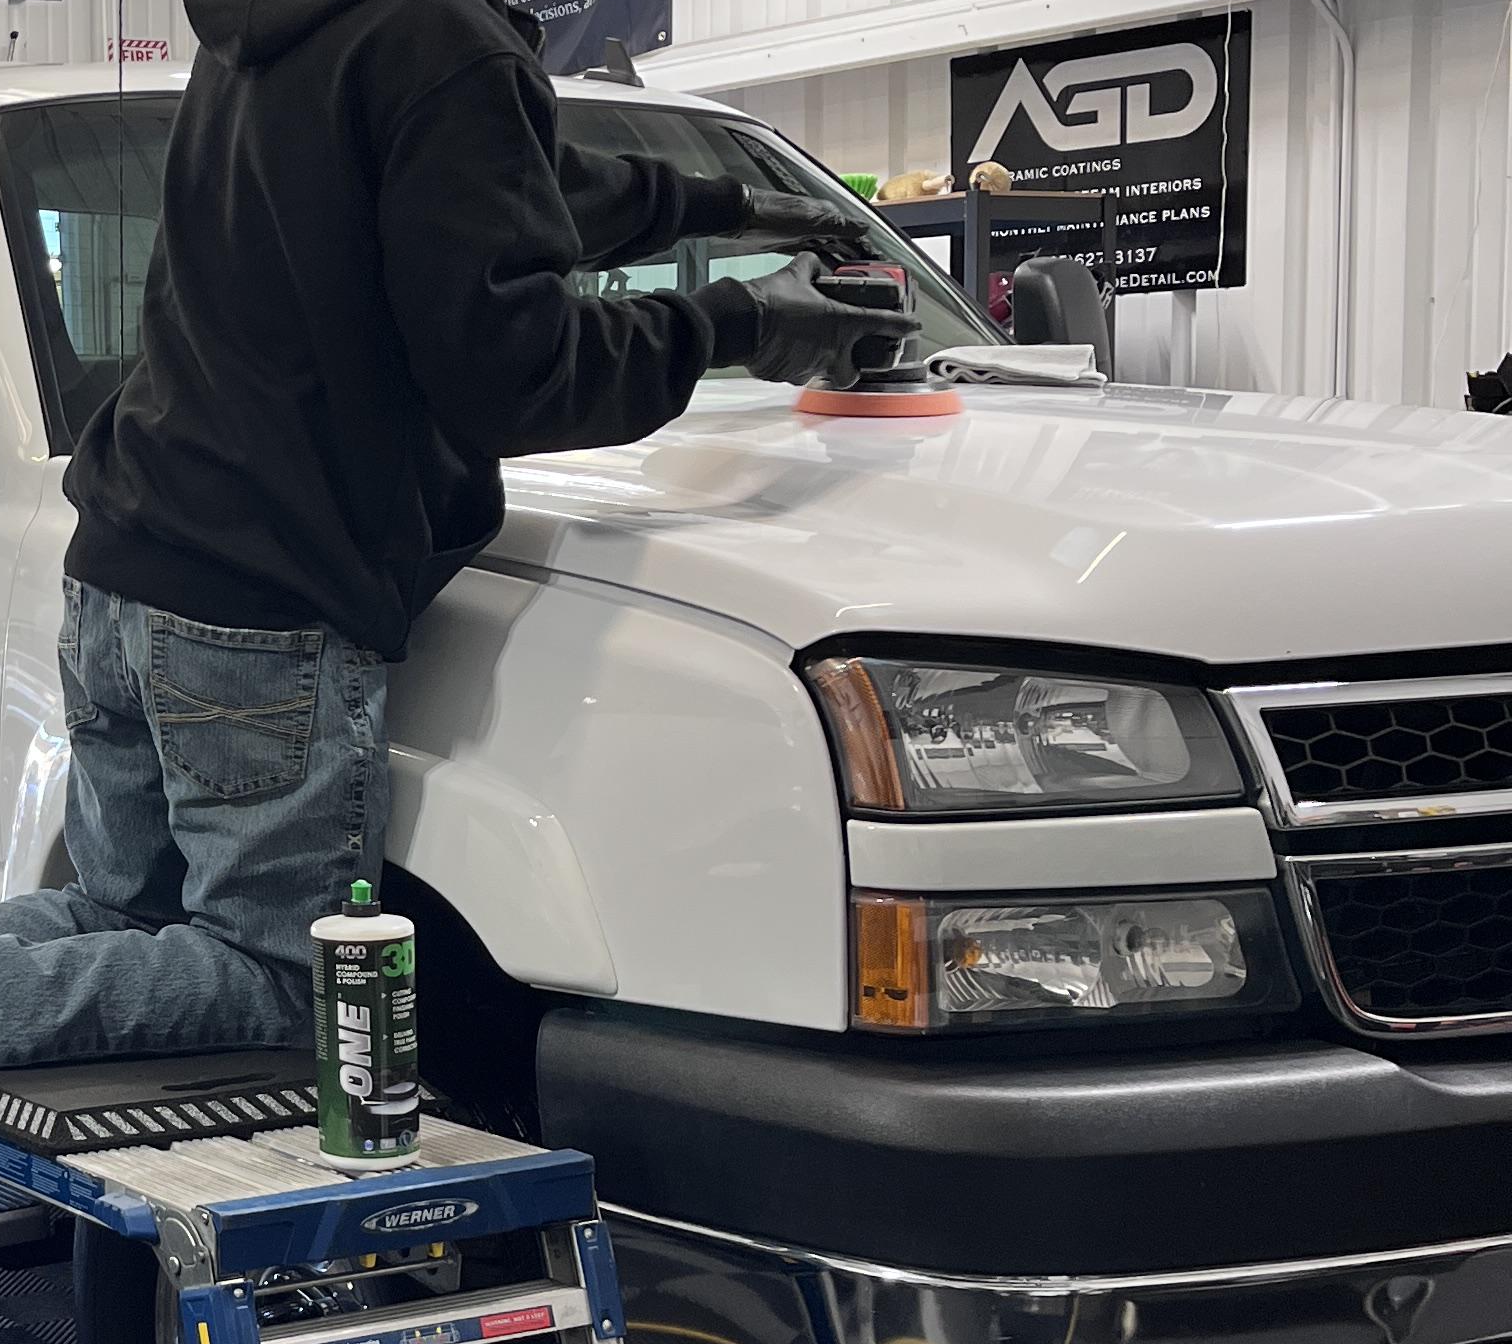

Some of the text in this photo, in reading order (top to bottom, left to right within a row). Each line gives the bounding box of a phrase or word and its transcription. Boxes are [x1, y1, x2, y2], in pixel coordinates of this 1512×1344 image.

[966, 42, 1218, 164] AGD
[1007, 158, 1122, 182] RAMIC COATINGS
[1125, 177, 1202, 198] INTERIORS
[1161, 206, 1211, 222] PLANS
[335, 944, 367, 960] 400
[381, 940, 416, 978] 3D
[337, 1000, 373, 1097] ONE
[385, 1205, 456, 1228] WERNER
